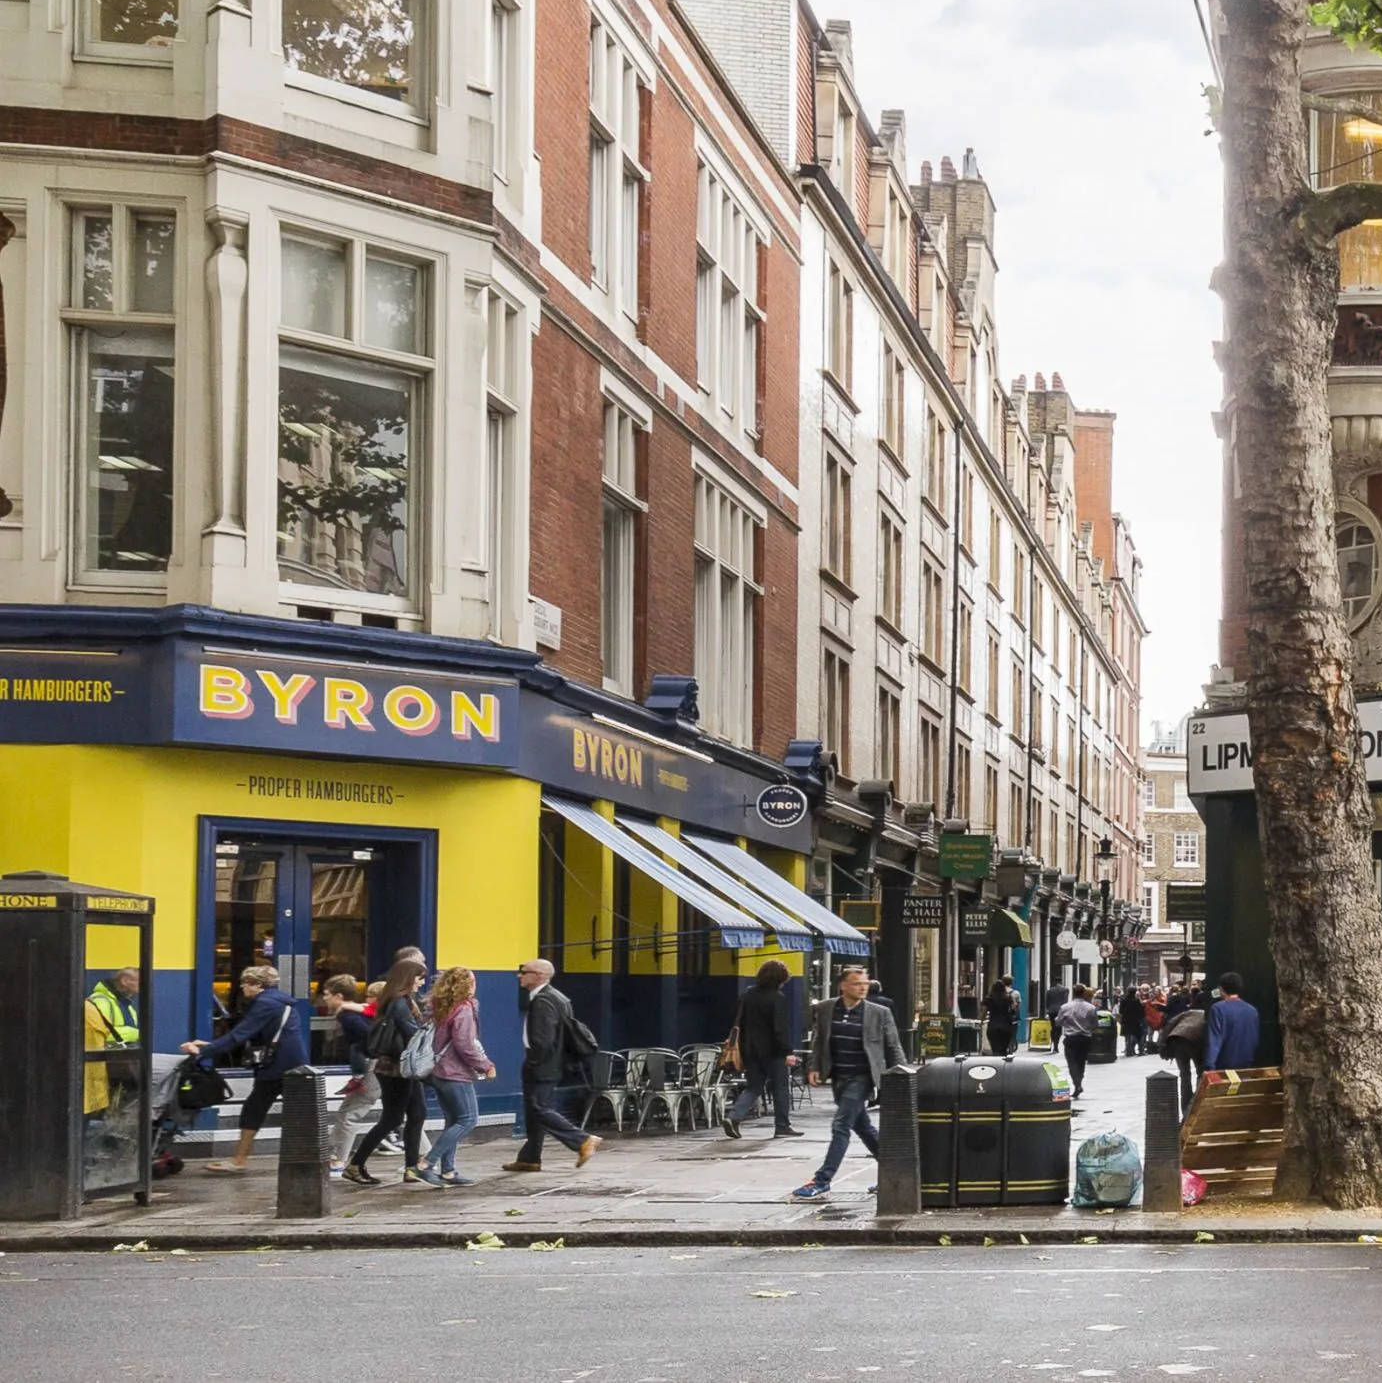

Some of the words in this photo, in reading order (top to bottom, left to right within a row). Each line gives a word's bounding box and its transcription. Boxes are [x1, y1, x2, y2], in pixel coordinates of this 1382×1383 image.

[13, 679, 112, 703] HAMBURGERS
[200, 664, 500, 743] BYRON
[1192, 723, 1206, 734] 22
[572, 728, 642, 789] BYRON
[1201, 741, 1253, 771] LIPM
[249, 776, 301, 798] PROPER
[305, 780, 394, 806] HAMBURGERS
[762, 800, 802, 810] BYRON
[903, 899, 942, 908] PANTER
[914, 908, 942, 916] HALL
[902, 917, 941, 925] GALLERY
